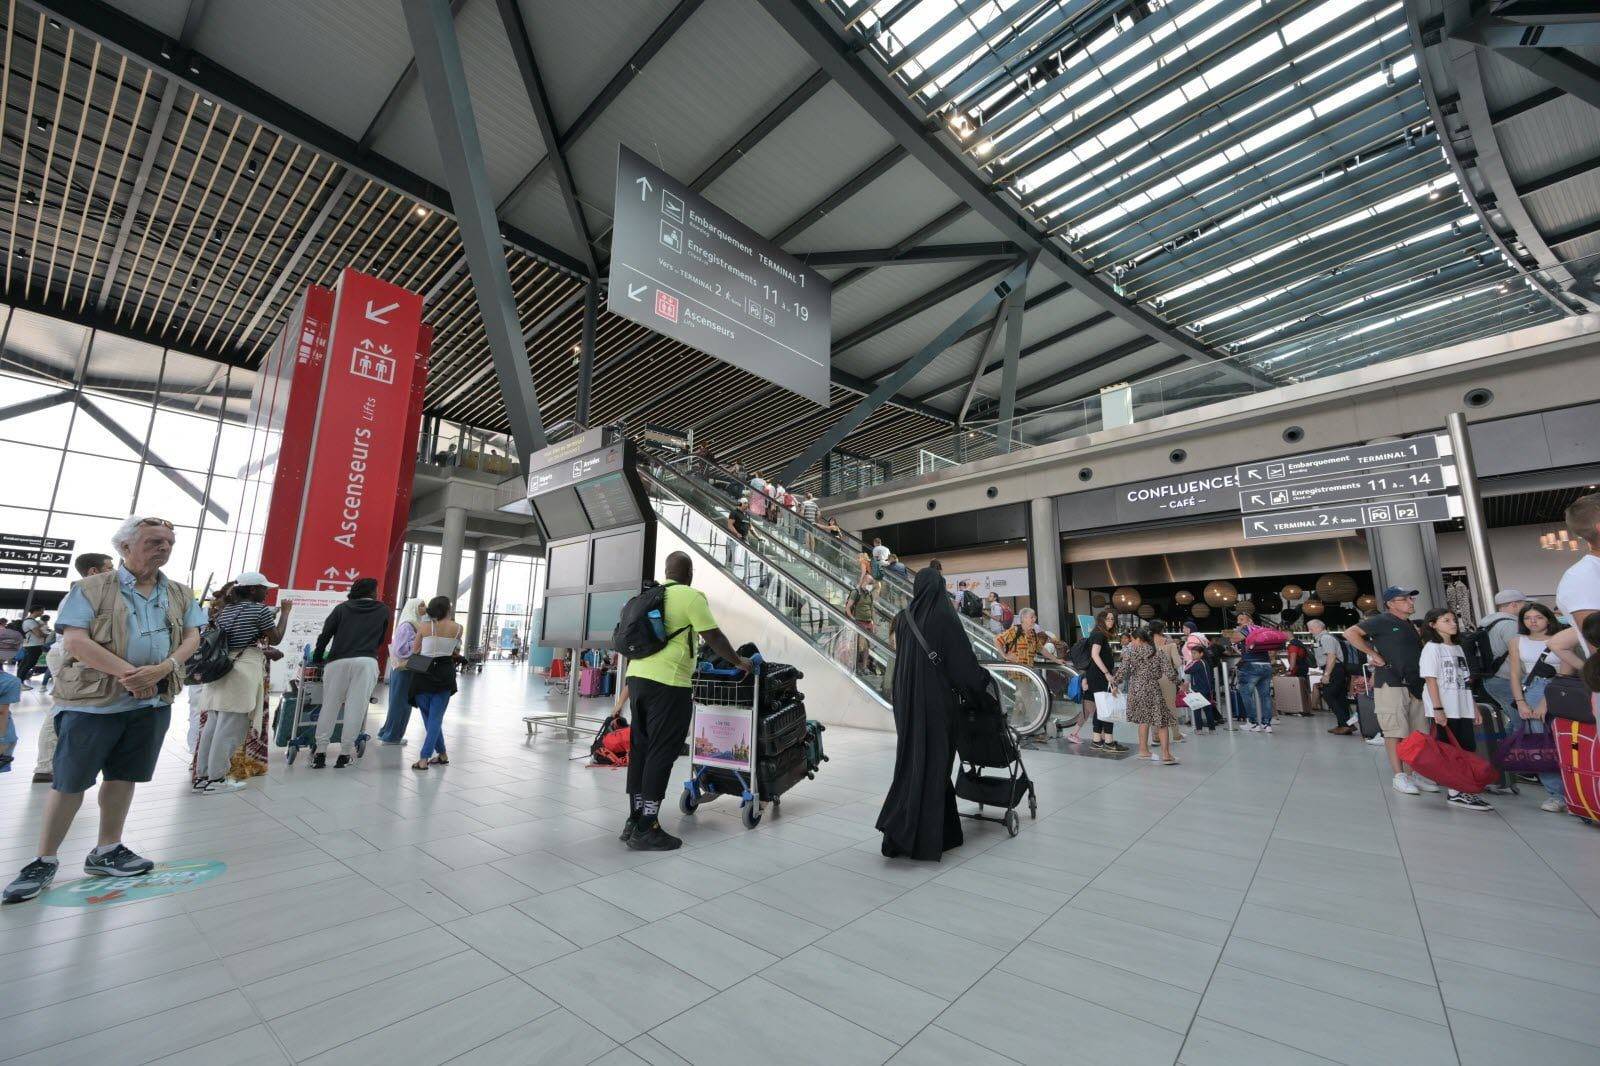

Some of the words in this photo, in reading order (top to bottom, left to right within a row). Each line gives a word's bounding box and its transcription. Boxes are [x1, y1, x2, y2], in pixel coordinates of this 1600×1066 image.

[689, 210, 753, 257] Embarquement
[758, 253, 797, 283] TERMINAL
[799, 274, 806, 288] 1
[680, 269, 712, 292] TERMINAL
[715, 283, 722, 297] 2
[688, 240, 757, 286] Enregistrements
[763, 285, 778, 305] 11
[793, 302, 809, 322] 19
[684, 308, 735, 339] Ascenseurs
[1288, 455, 1350, 470] Embarquement
[1357, 451, 1407, 464] TERMINAL
[1409, 444, 1418, 456] 1
[334, 427, 371, 548] Ascenseurs
[363, 397, 376, 421] Lifts
[1292, 482, 1361, 497] Enregistrements
[1368, 478, 1387, 491] 11
[1409, 472, 1432, 486] 14
[1169, 496, 1195, 509] CAFÉ
[1273, 520, 1317, 530] TERMINAL
[1318, 514, 1330, 526] 2
[1398, 508, 1415, 518] P2
[26, 552, 38, 560] 14
